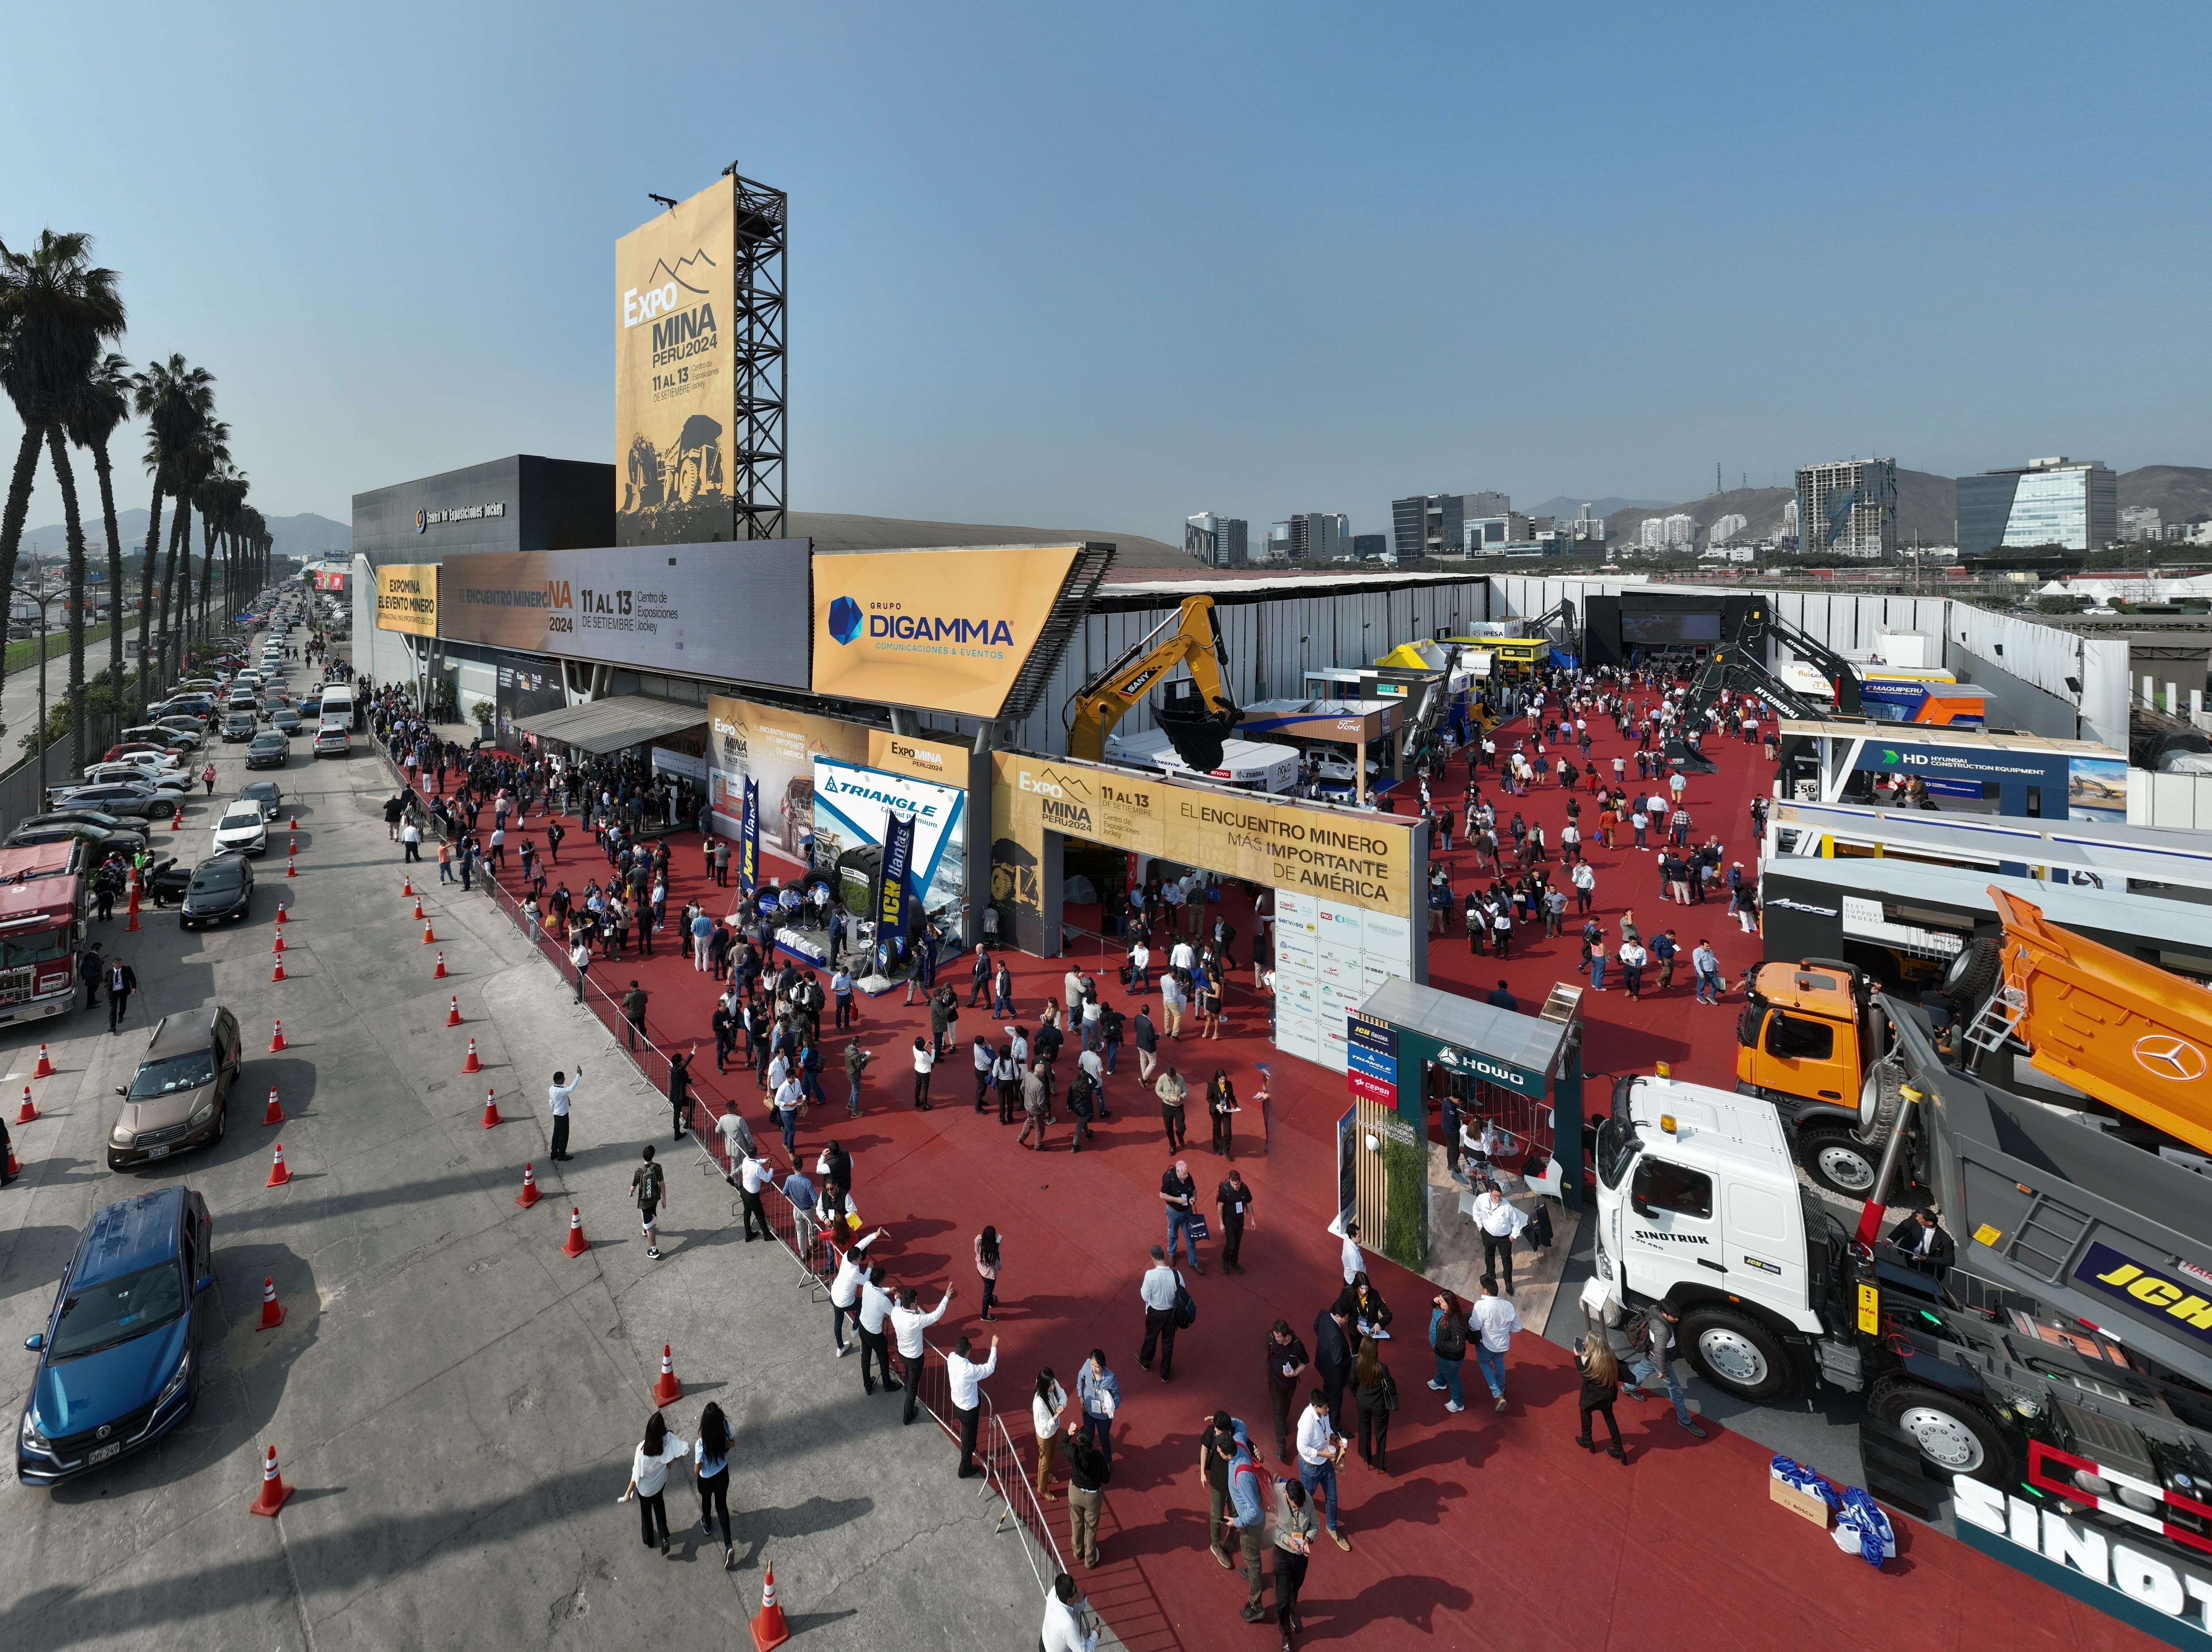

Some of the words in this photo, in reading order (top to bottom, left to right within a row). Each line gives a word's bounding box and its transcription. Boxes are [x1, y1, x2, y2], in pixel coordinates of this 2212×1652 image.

[624, 282, 677, 328] EXPO
[653, 303, 717, 353] MINA
[692, 362, 706, 372] Centro
[692, 368, 719, 381] Exposiciones
[653, 375, 661, 391] 11
[663, 374, 676, 388] AL
[678, 366, 688, 383] 13
[692, 381, 705, 390] Jockey
[653, 392, 660, 402] DE
[661, 384, 690, 400] SETIEMBRE
[426, 512, 441, 523] Centro
[442, 510, 448, 521] de
[449, 506, 483, 522] Exposiciones
[485, 502, 503, 517] Jockey
[390, 579, 420, 594] EXPOMINA
[378, 596, 384, 609] EL
[386, 596, 408, 611] EVENTO
[410, 598, 434, 613] MINERO
[459, 589, 466, 603] EL
[467, 589, 512, 606] ENCUENTRO
[513, 591, 549, 608] MINERO
[581, 590, 593, 613] 11
[596, 594, 614, 614] AL
[616, 590, 632, 615] 13
[637, 591, 657, 603] Centro
[659, 591, 667, 603] de
[378, 613, 397, 621] INTERNACIONAL
[403, 615, 420, 624] IMPORTANTE
[638, 606, 678, 620] Exposiciones
[1542, 616, 1555, 625] DEERE
[549, 617, 573, 633] 2024
[583, 616, 591, 627] DE
[593, 617, 634, 631] SETIEMBRE
[637, 620, 657, 635] Jockey
[870, 614, 1014, 646] DIGAMMA
[876, 642, 949, 654] COMUNICACIONES
[961, 648, 1003, 659] EVENTOS
[1786, 638, 1812, 656] HYUNDAI
[1128, 671, 1150, 693] SANY
[1873, 686, 1924, 694] MAQUIPERU
[1754, 686, 1800, 720] HYUNDAI
[715, 718, 735, 736] EXPO
[759, 725, 786, 737] ENCUENTRO
[787, 732, 805, 742] MINERO
[1337, 720, 1361, 732] Ford
[724, 736, 747, 752] MINA
[766, 735, 776, 743] MÁS
[776, 739, 805, 751] IMPORTANTE
[783, 750, 803, 760] AMÉRICA
[892, 742, 942, 764] EXPOMINA
[1903, 754, 1928, 765] HD
[1151, 759, 1181, 768] ECHODYNE
[1931, 761, 1994, 771] CONSTRUCTION
[1995, 766, 2045, 775] EQUIPMENT
[1019, 770, 1063, 798] EXPO
[841, 782, 937, 817] TRIANGLE
[1102, 786, 1113, 799] 11
[1116, 792, 1132, 805] AL
[1134, 793, 1149, 808] 13
[1043, 798, 1091, 824] MINA
[1113, 802, 1152, 817] SETIEMBRE
[906, 813, 937, 828] Pemium
[1103, 813, 1122, 823] Centro
[1103, 829, 1121, 839] Jockey
[1104, 821, 1140, 836] Exposiciones
[1181, 802, 1198, 819] EL
[1202, 807, 1305, 840] ENCUENTRO
[1310, 828, 1388, 856] MINERO
[1228, 832, 1262, 852] MÁS
[1267, 842, 1388, 880] IMPORTANTE
[1274, 862, 1296, 882] DE
[1300, 869, 1389, 902] AMÉRICA
[883, 878, 901, 926] JCH
[1845, 908, 1882, 919] SUPPORT
[1278, 918, 1303, 928] servosa
[1367, 923, 1388, 931] STANTON
[775, 928, 800, 948] JCH
[1288, 945, 1313, 955] AngloAmerican
[1321, 1012, 1343, 1022] Newmont
[1355, 1026, 1370, 1036] JCH
[1352, 1054, 1391, 1072] TRIANGLE
[1463, 1057, 1524, 1085] HOWO
[1365, 1082, 1390, 1096] CEPSA
[1388, 1125, 1414, 1139] MINERIA
[1395, 1121, 1413, 1132] LIDER
[1364, 1122, 1414, 1147] CONSTRUCCION
[1630, 1236, 1646, 1244] T7H
[1635, 1230, 1710, 1244] SINOTRUK
[1746, 1258, 1762, 1267] JCH
[2096, 1264, 2212, 1330] JCH
[1793, 1504, 1813, 1518] BOSCH
